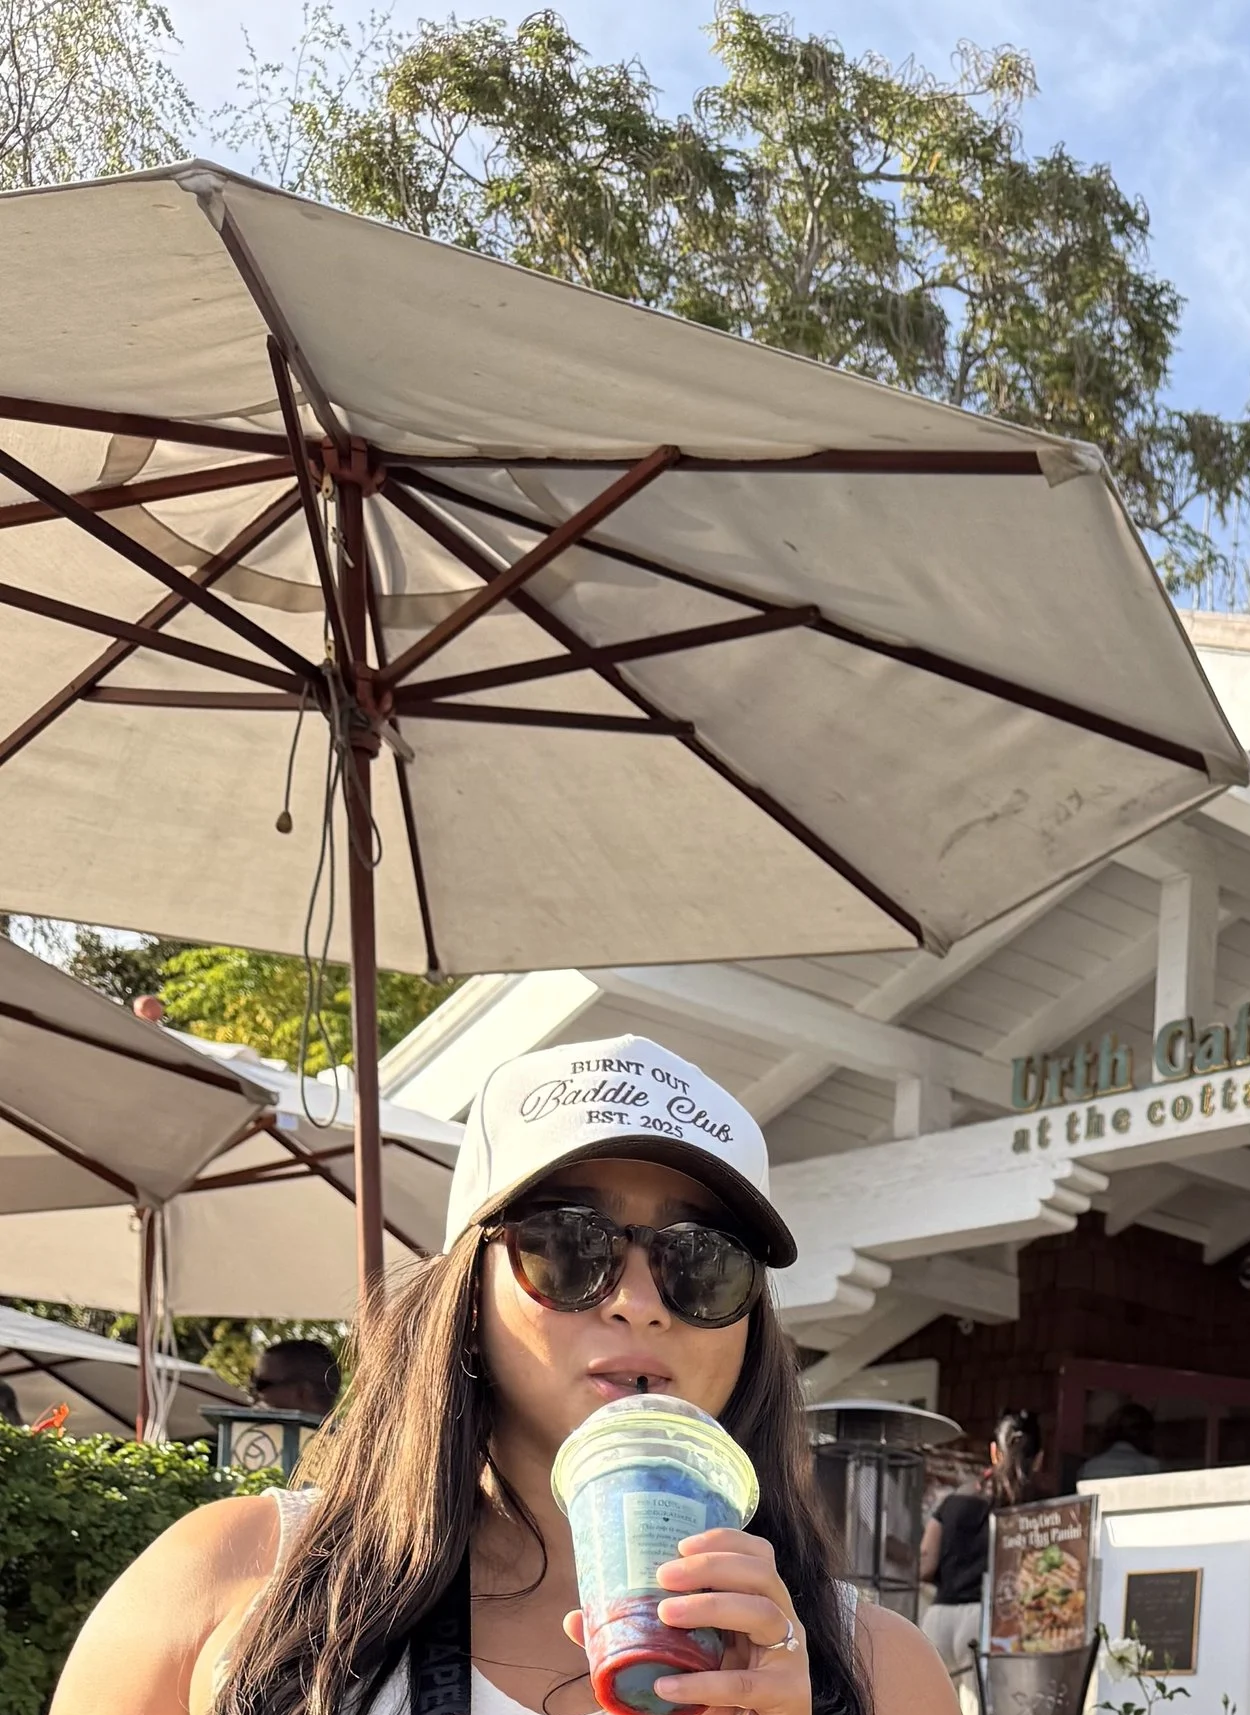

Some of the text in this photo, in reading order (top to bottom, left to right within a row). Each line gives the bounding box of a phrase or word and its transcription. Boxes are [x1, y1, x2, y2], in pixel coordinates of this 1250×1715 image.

[571, 1059, 690, 1095] BURNT OUT
[1012, 1031, 1134, 1112] Urth
[520, 1079, 733, 1143] Baddie Club
[586, 1111, 684, 1139] EST. 2025
[1012, 1116, 1051, 1153] at
[1065, 1104, 1131, 1144] the
